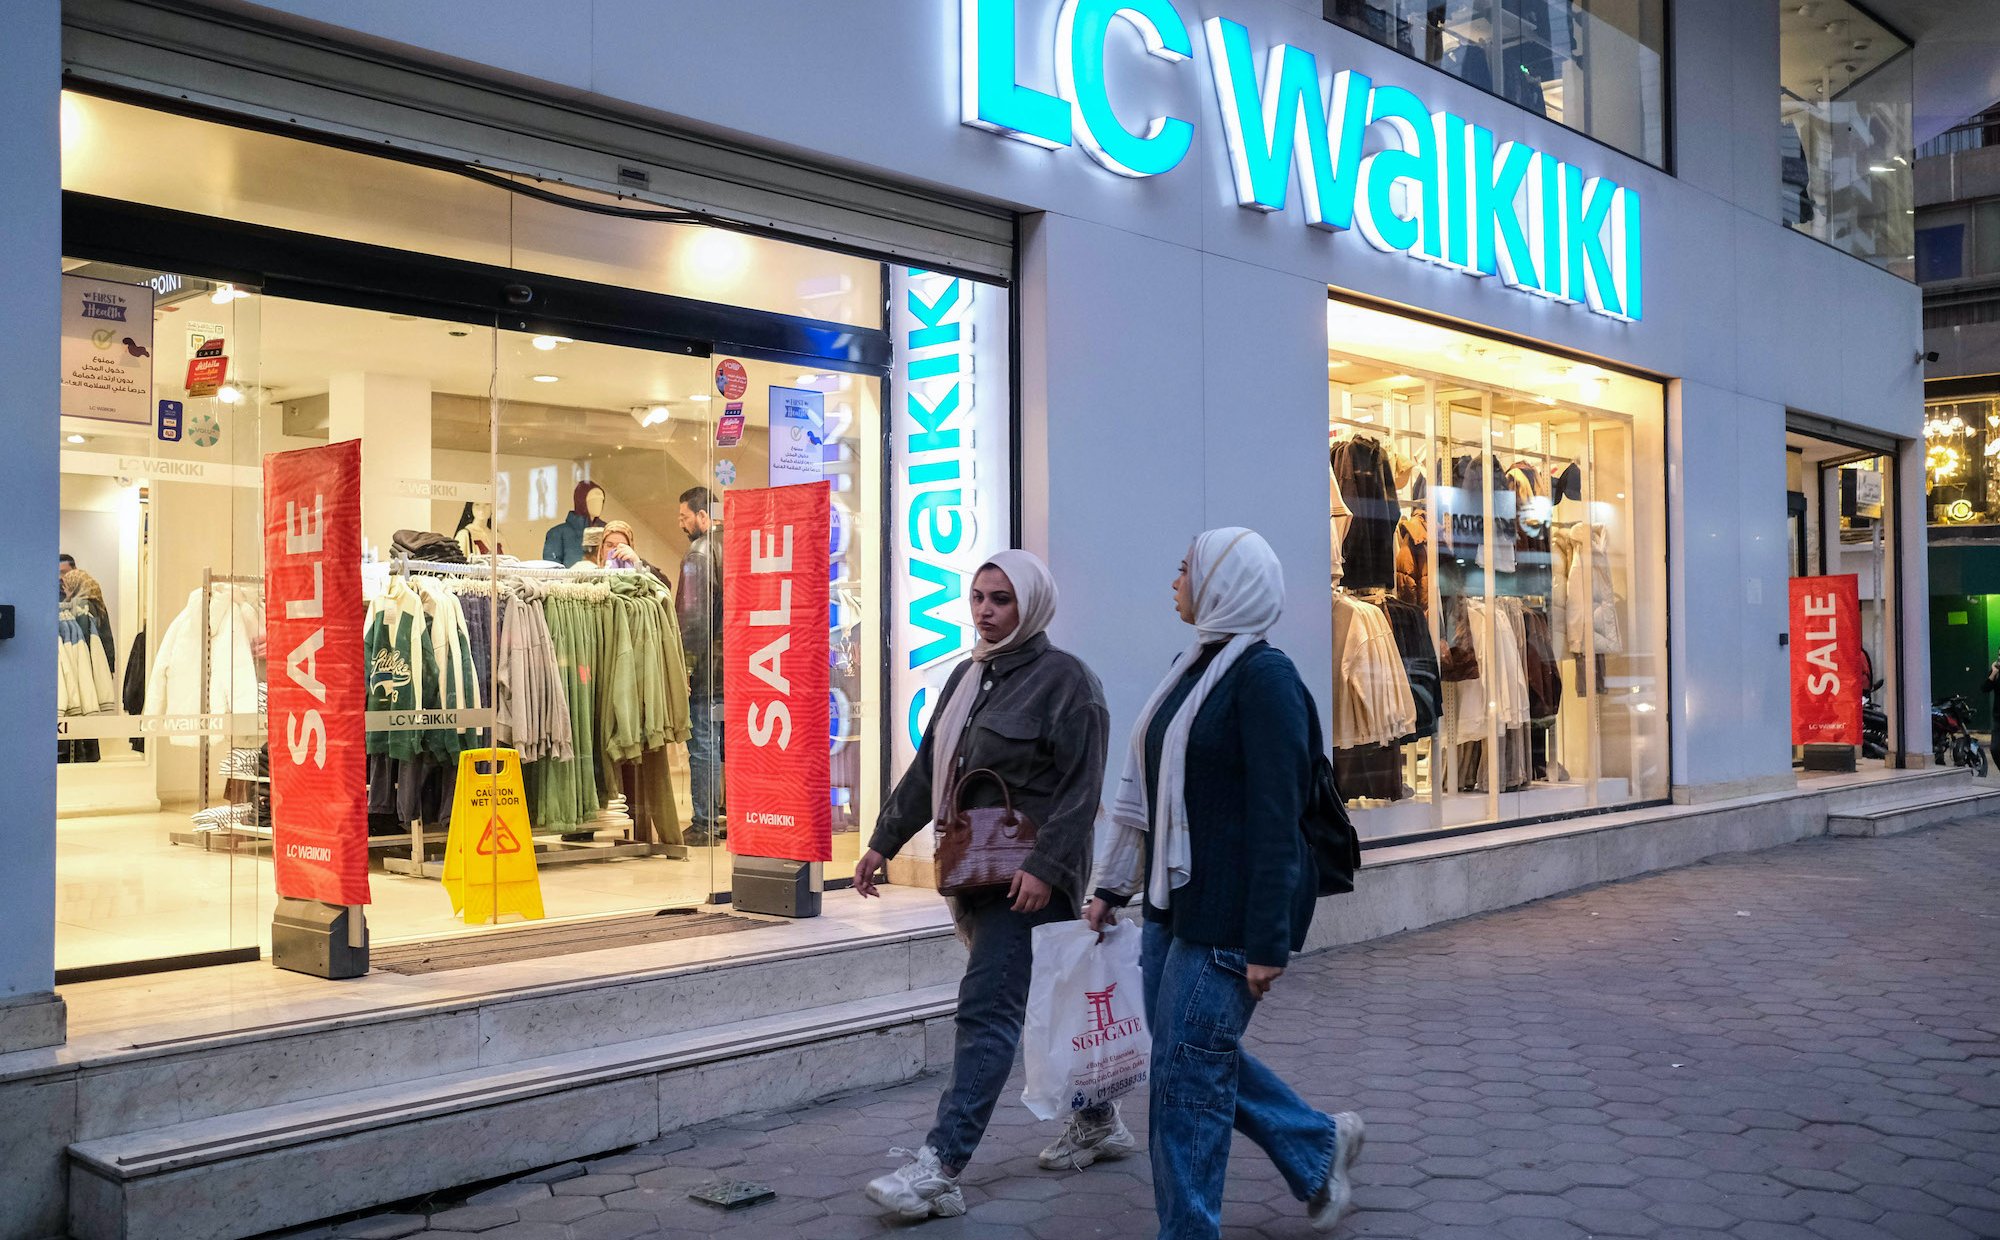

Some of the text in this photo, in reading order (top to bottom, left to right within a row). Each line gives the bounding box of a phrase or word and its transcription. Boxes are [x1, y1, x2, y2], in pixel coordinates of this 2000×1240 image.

[961, 0, 1194, 178] LC
[151, 273, 182, 295] POINT
[92, 292, 117, 304] FIRST
[87, 303, 122, 319] Health
[92, 356, 115, 365] ممنوع
[82, 364, 104, 372] المحل
[908, 267, 962, 670] WaIKIK
[286, 494, 327, 770] SALE
[747, 524, 793, 751] SALE
[1804, 592, 1841, 697] SALE
[140, 719, 157, 732] LC
[389, 715, 405, 726] LC
[476, 788, 514, 797] CAUION
[471, 797, 520, 807] WET LOOR
[746, 812, 758, 824] LC
[286, 844, 298, 858] LC
